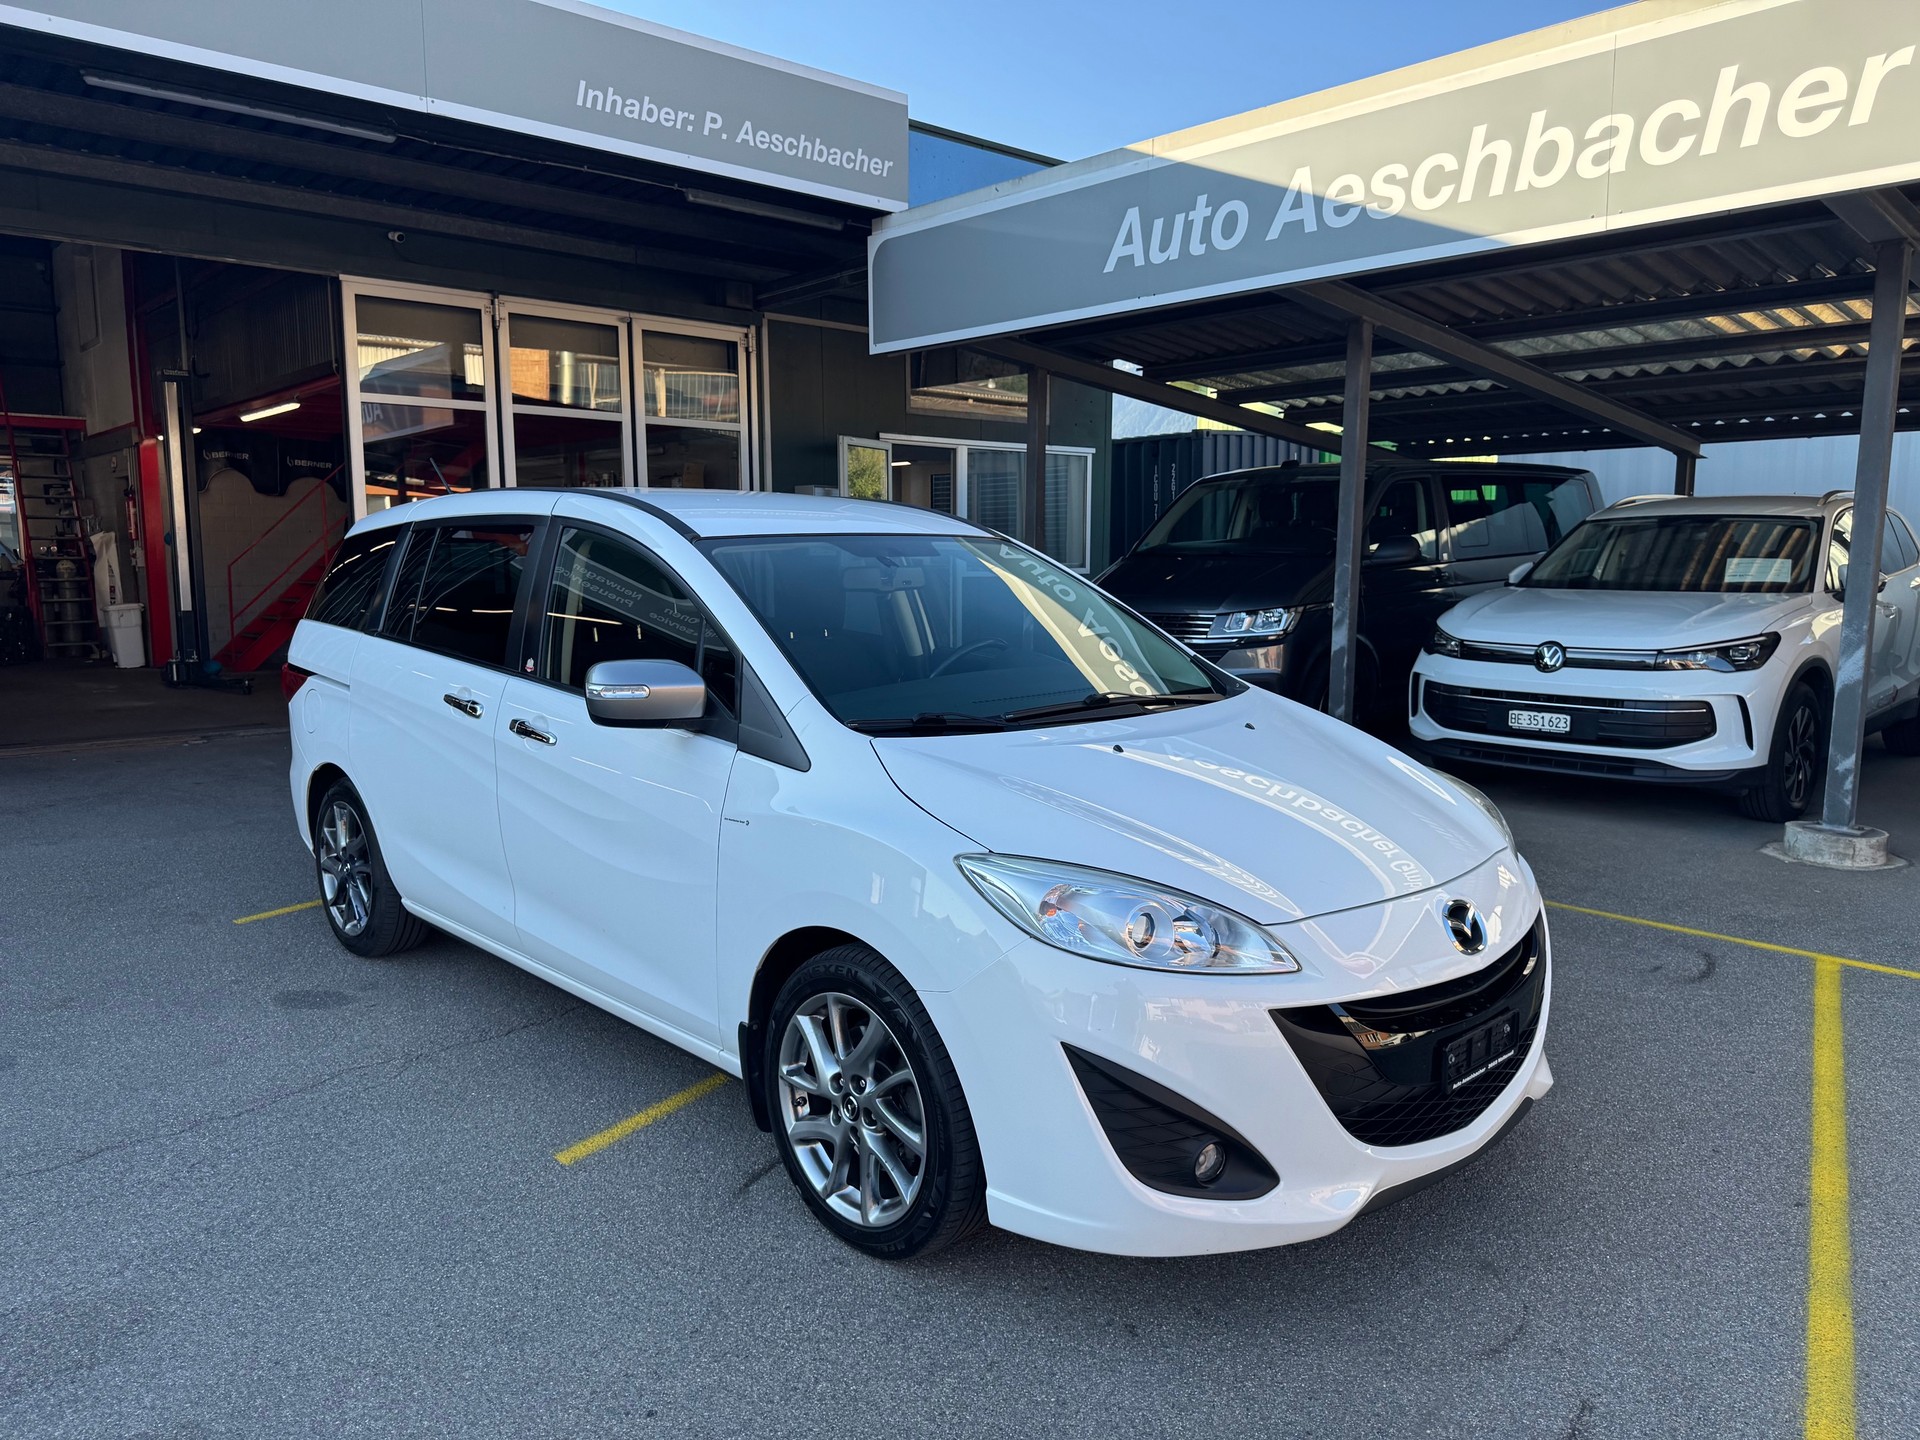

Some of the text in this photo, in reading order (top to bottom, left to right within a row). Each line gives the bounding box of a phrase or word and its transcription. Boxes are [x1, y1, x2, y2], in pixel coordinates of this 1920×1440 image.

[576, 79, 894, 178] Inhaber: P. Aeschbacher
[1103, 45, 1916, 273] Auto Aeschbacher
[294, 459, 332, 469] BERNER
[800, 963, 859, 983] NEXEN
